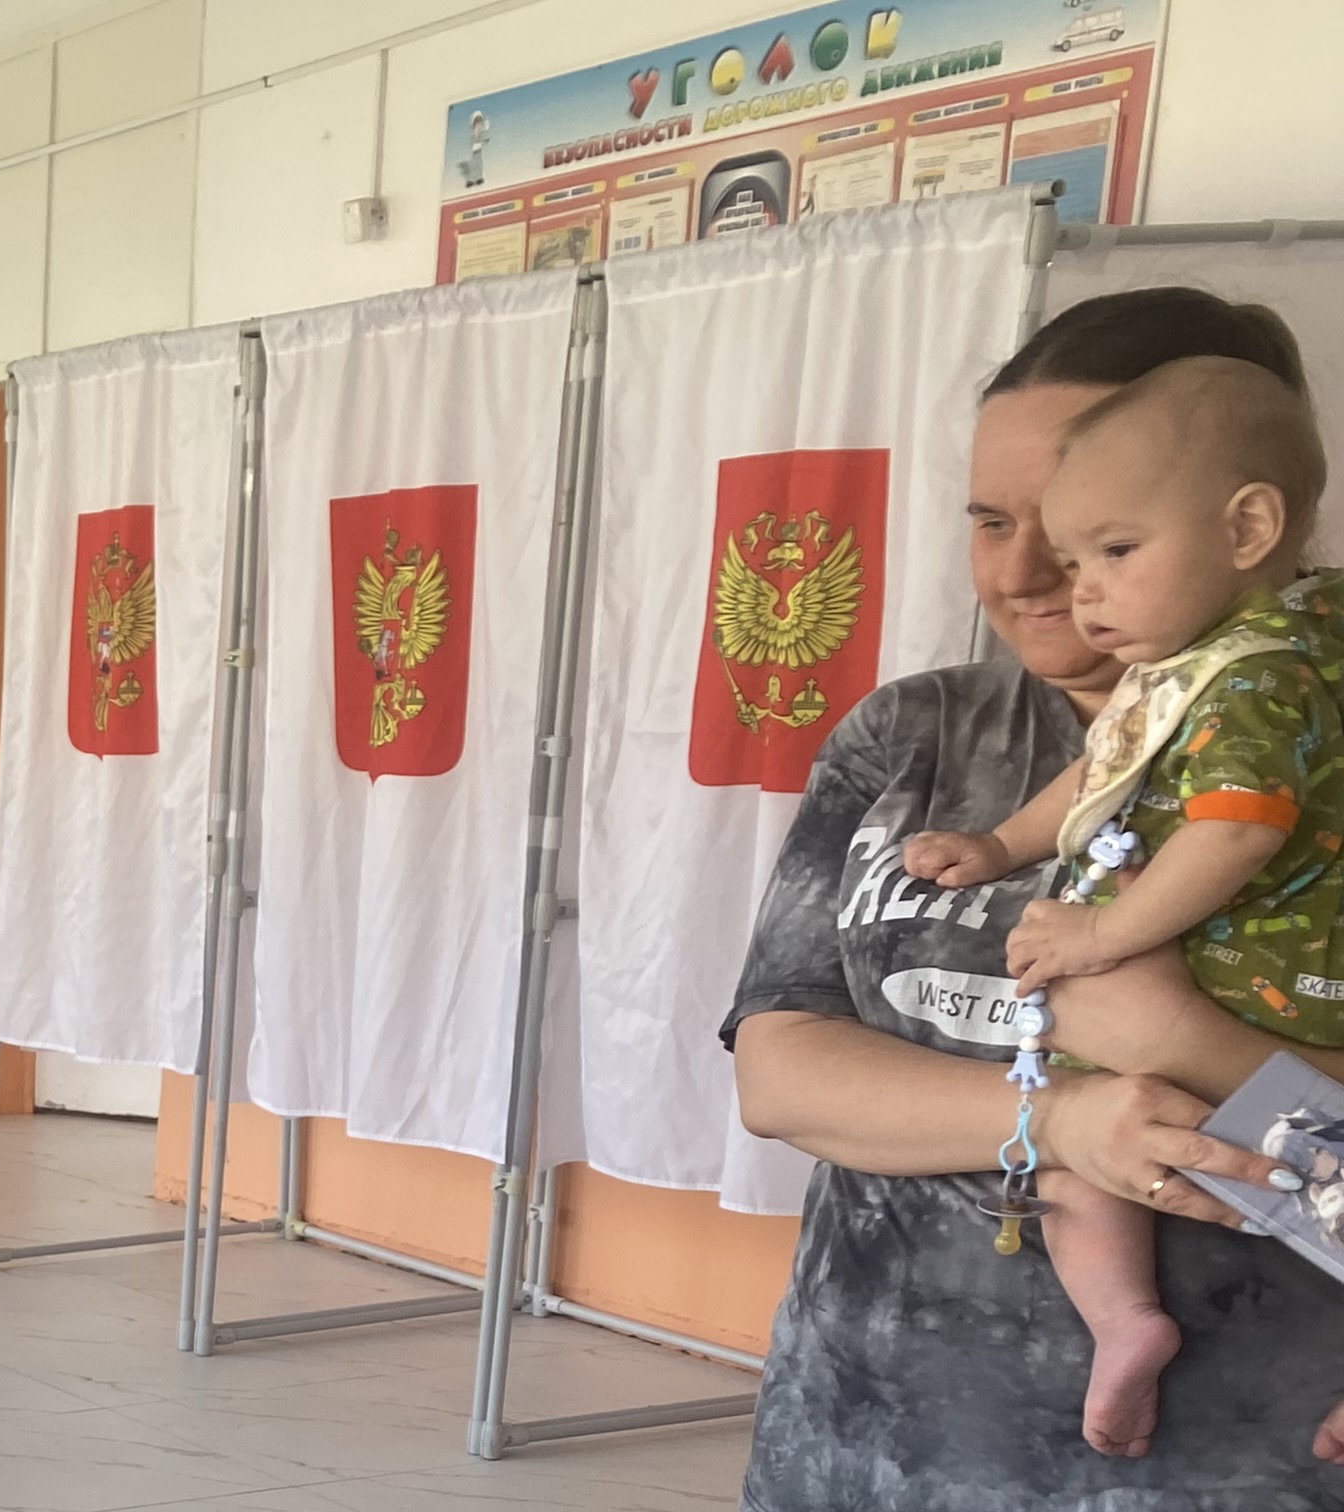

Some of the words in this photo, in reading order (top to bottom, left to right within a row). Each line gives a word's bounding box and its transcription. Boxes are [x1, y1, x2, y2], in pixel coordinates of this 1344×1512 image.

[627, 7, 903, 119] УГОЛОК
[703, 76, 849, 133] ДОРОЖНОГО
[1202, 942, 1244, 966] STREET
[917, 979, 982, 1021] WEST
[1296, 976, 1344, 1000] SKATE
